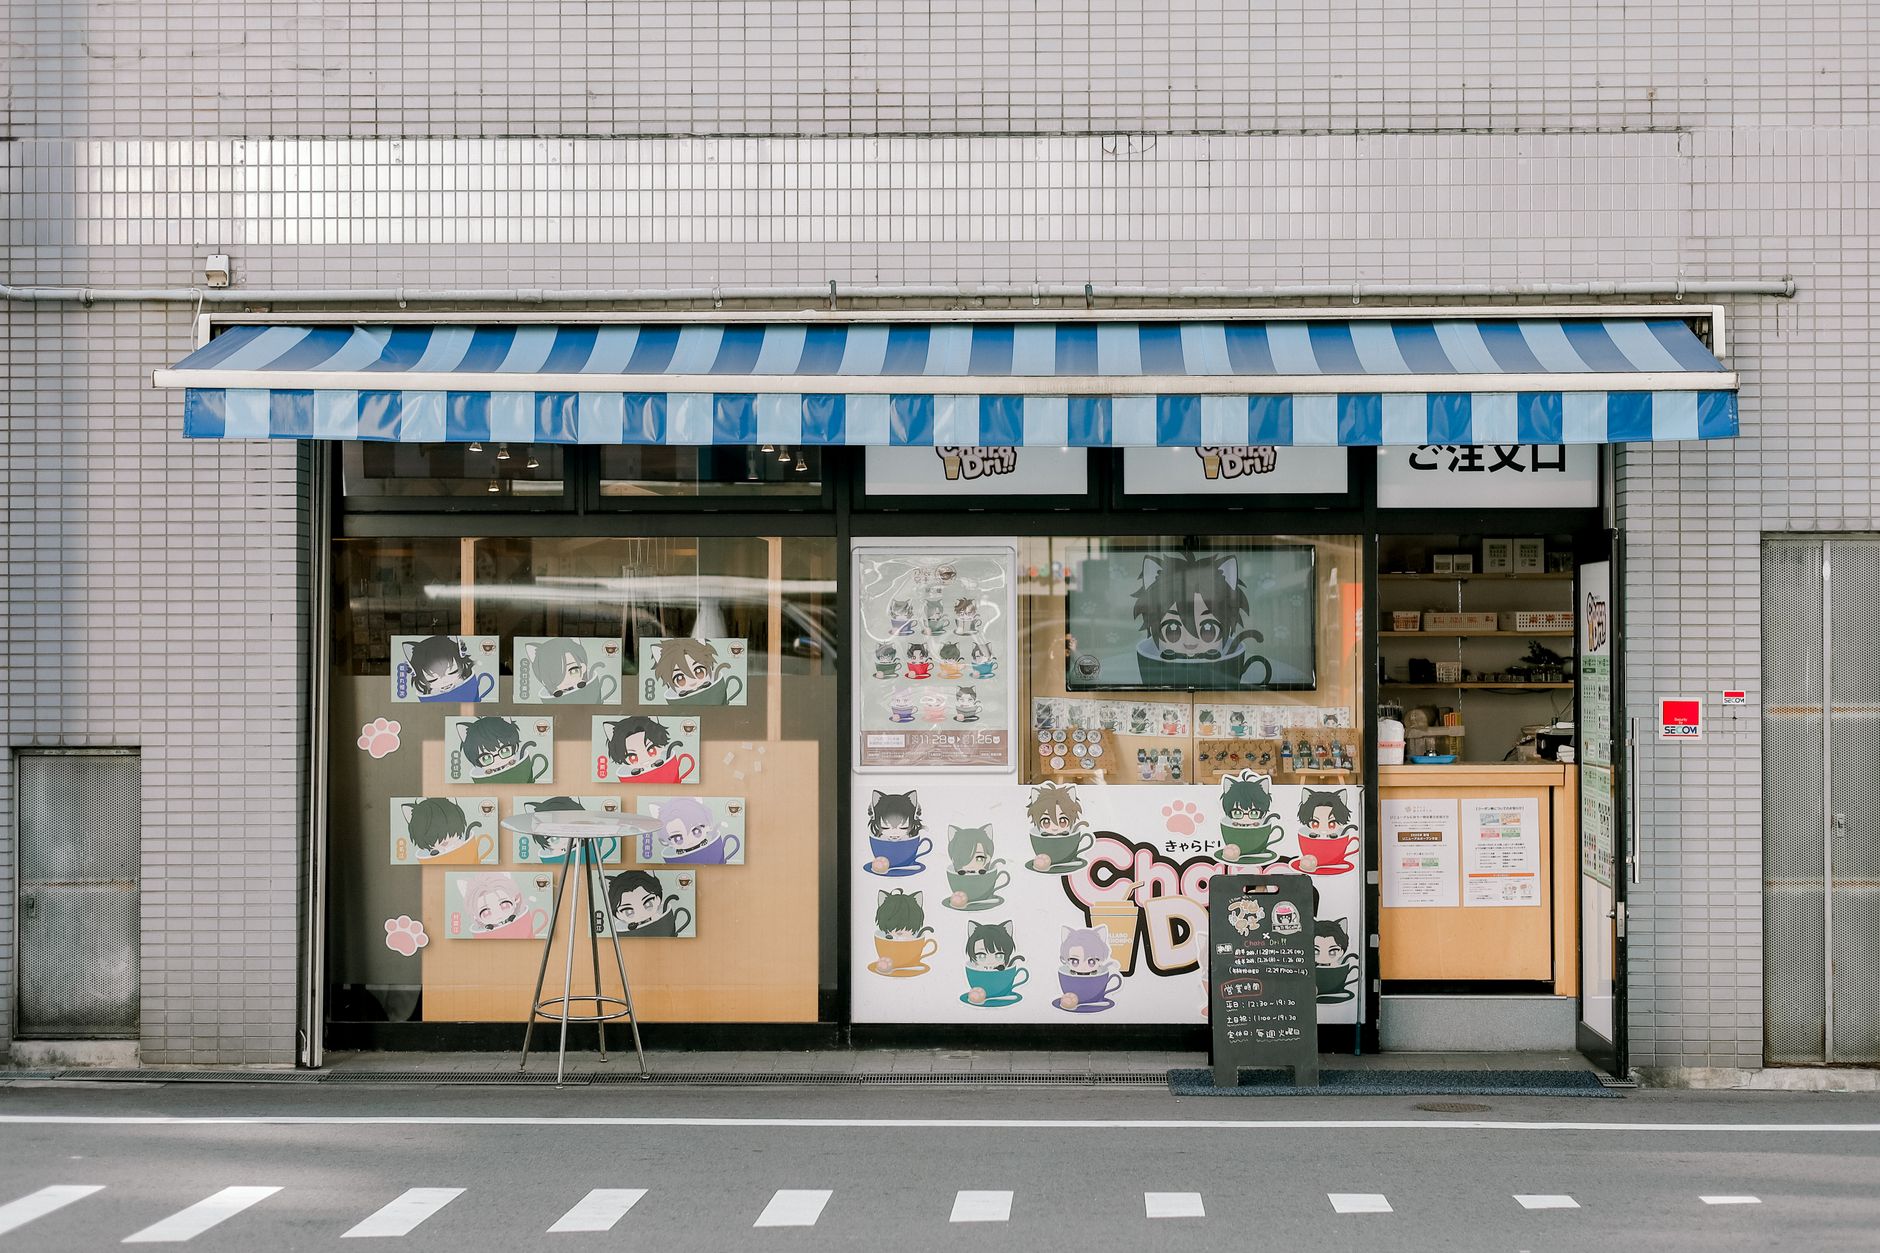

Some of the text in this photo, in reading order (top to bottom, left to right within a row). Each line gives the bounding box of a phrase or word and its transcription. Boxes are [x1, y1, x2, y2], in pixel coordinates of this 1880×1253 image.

[1664, 726, 1697, 735] SECOM
[1165, 840, 1222, 854] きゃらド
